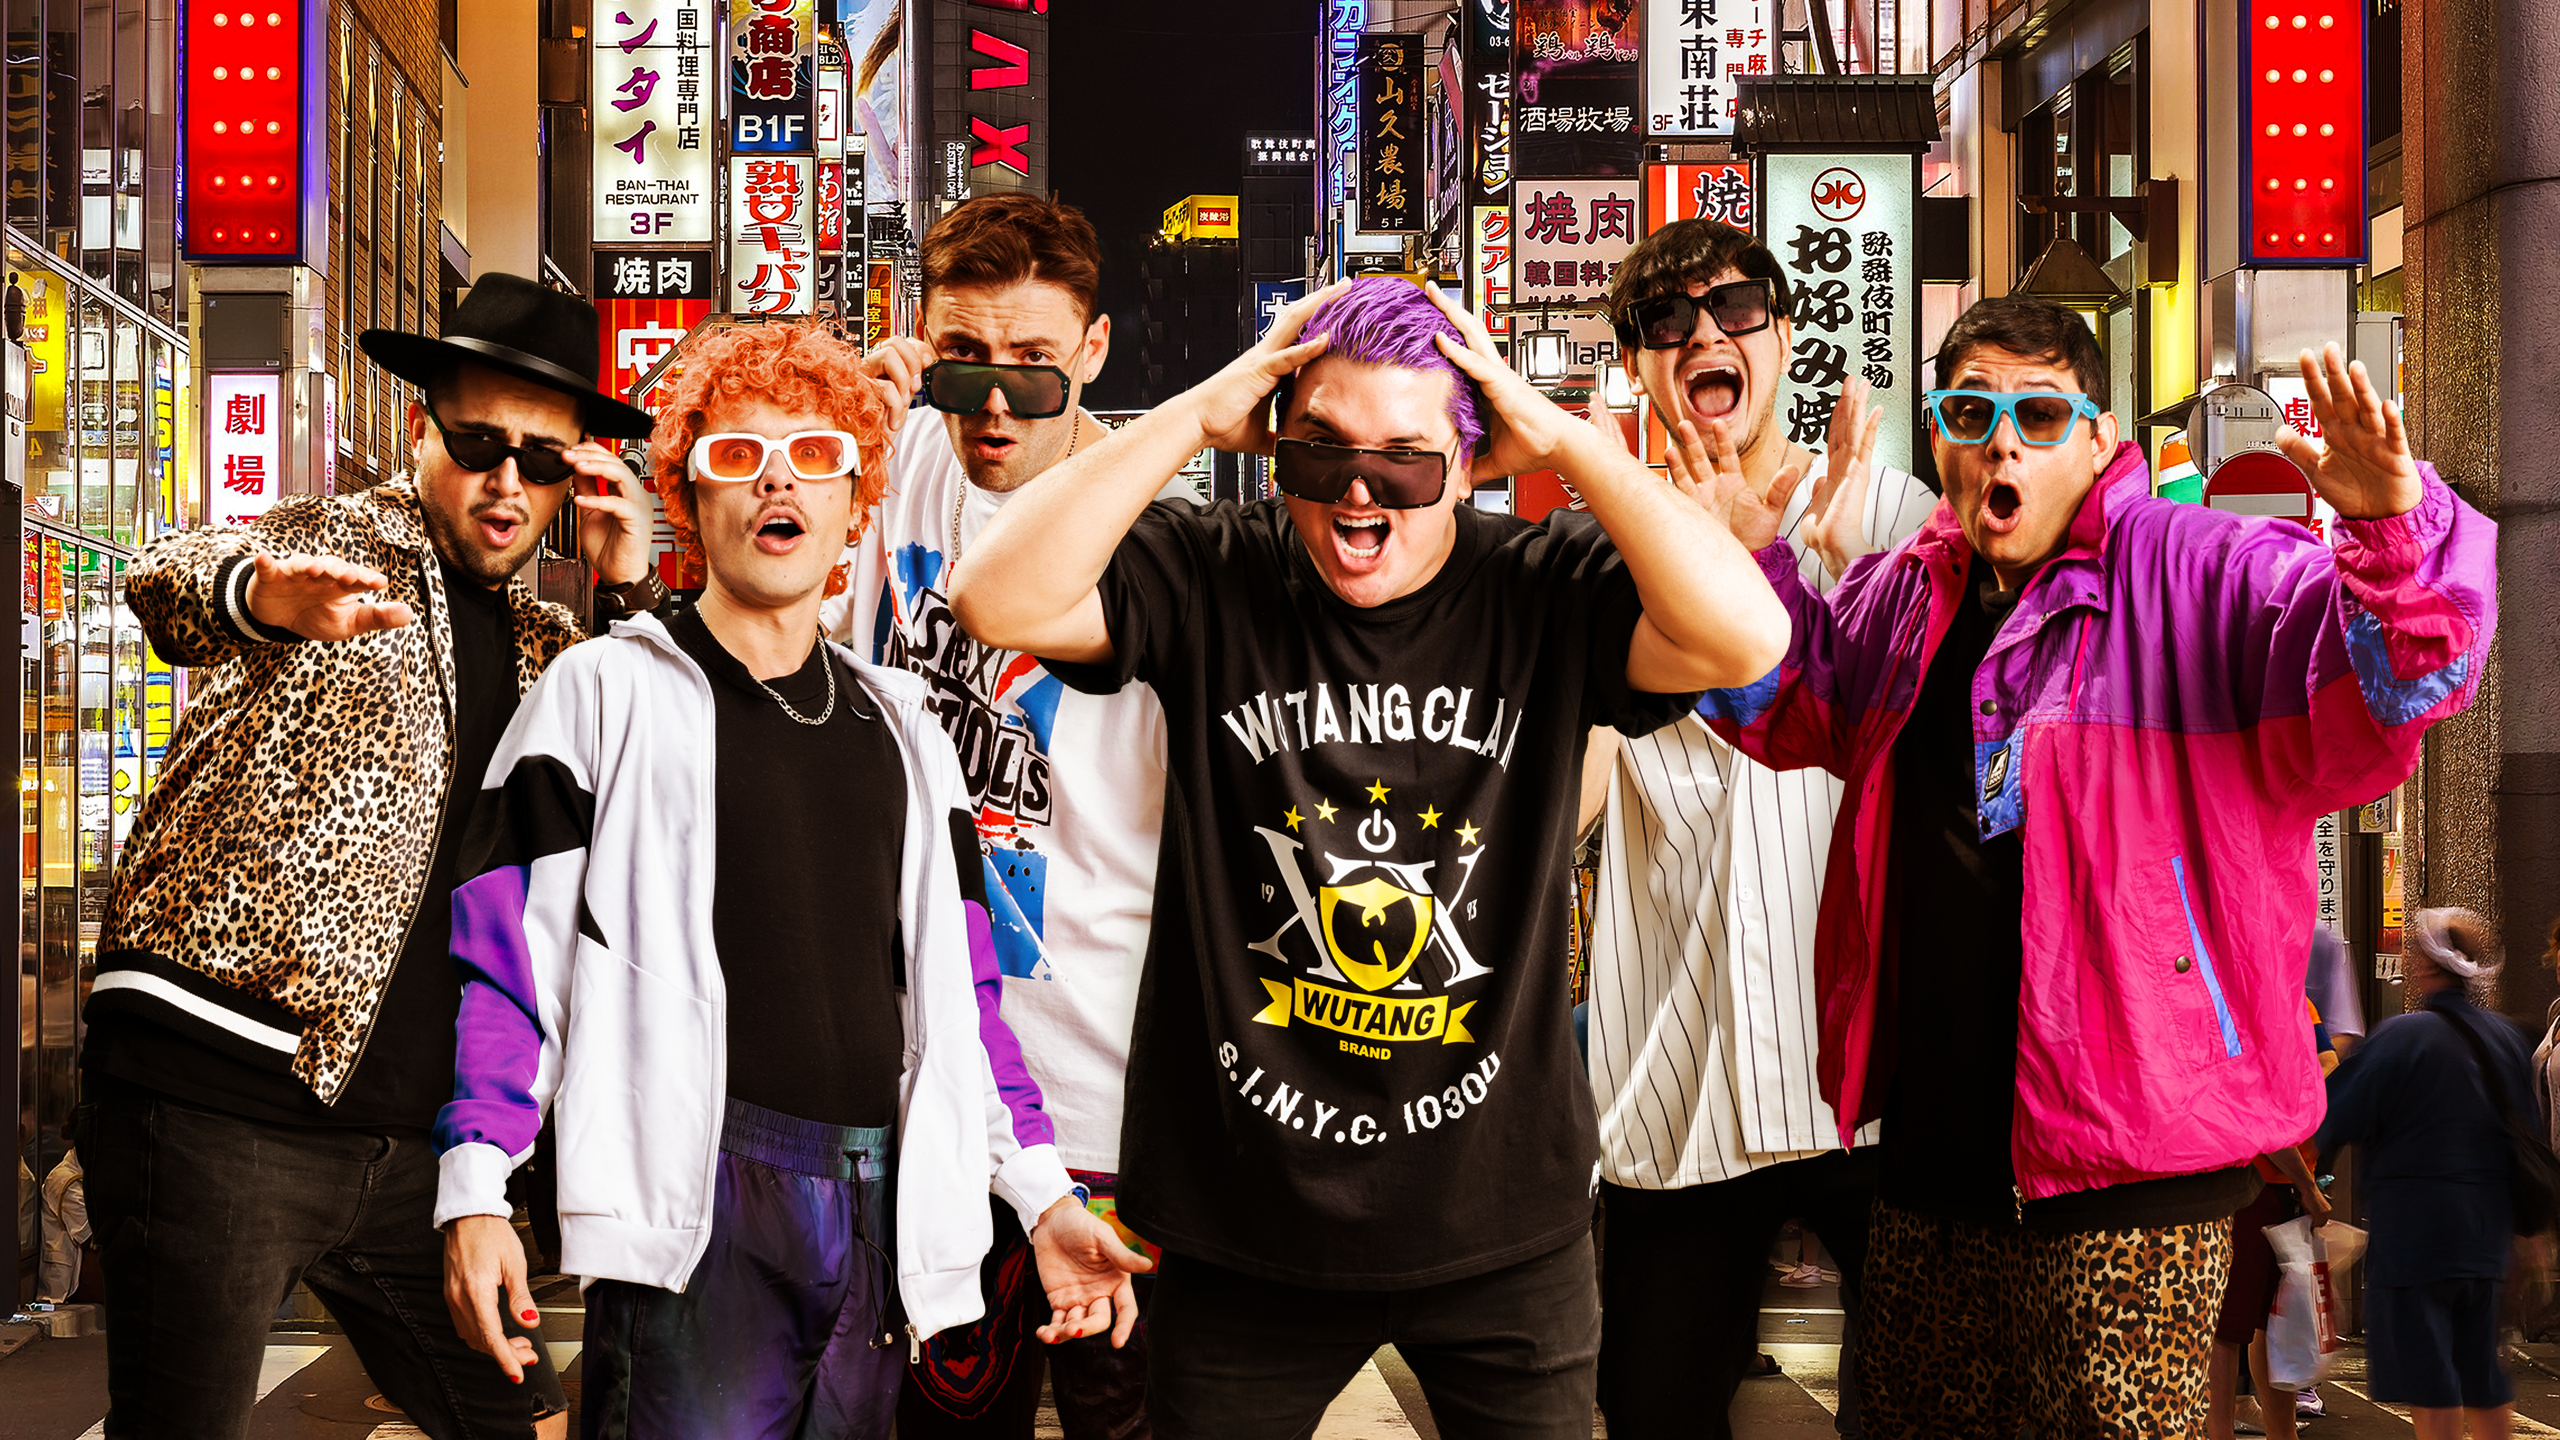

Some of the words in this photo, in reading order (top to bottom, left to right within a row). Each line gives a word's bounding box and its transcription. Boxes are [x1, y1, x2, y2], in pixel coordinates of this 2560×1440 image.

[748, 0, 797, 98] 商店
[676, 0, 700, 150] 国料理専門店
[1680, 0, 1719, 131] 東南荘
[739, 115, 805, 142] B1F
[1520, 106, 1634, 132] 酒場牧場
[1653, 115, 1674, 131] 3F
[1257, 151, 1316, 162] 振興組合
[616, 179, 690, 191] BAN-THAI
[605, 194, 699, 205] RESTAURANT
[630, 212, 674, 235] 3F
[1381, 217, 1404, 228] 5F
[1525, 191, 1636, 245] 焼肉
[1363, 256, 1384, 265] 6F
[613, 257, 693, 295] 焼肉
[867, 288, 882, 352] 個室ダ
[1861, 231, 1894, 389] 歌舞伎町名物
[1787, 225, 1855, 453] お好み焼
[2317, 812, 2337, 932] 全を守ります
[1261, 882, 1275, 903] 19
[1303, 987, 1436, 1036] WUTANG
[1339, 1039, 1392, 1061] BRAND
